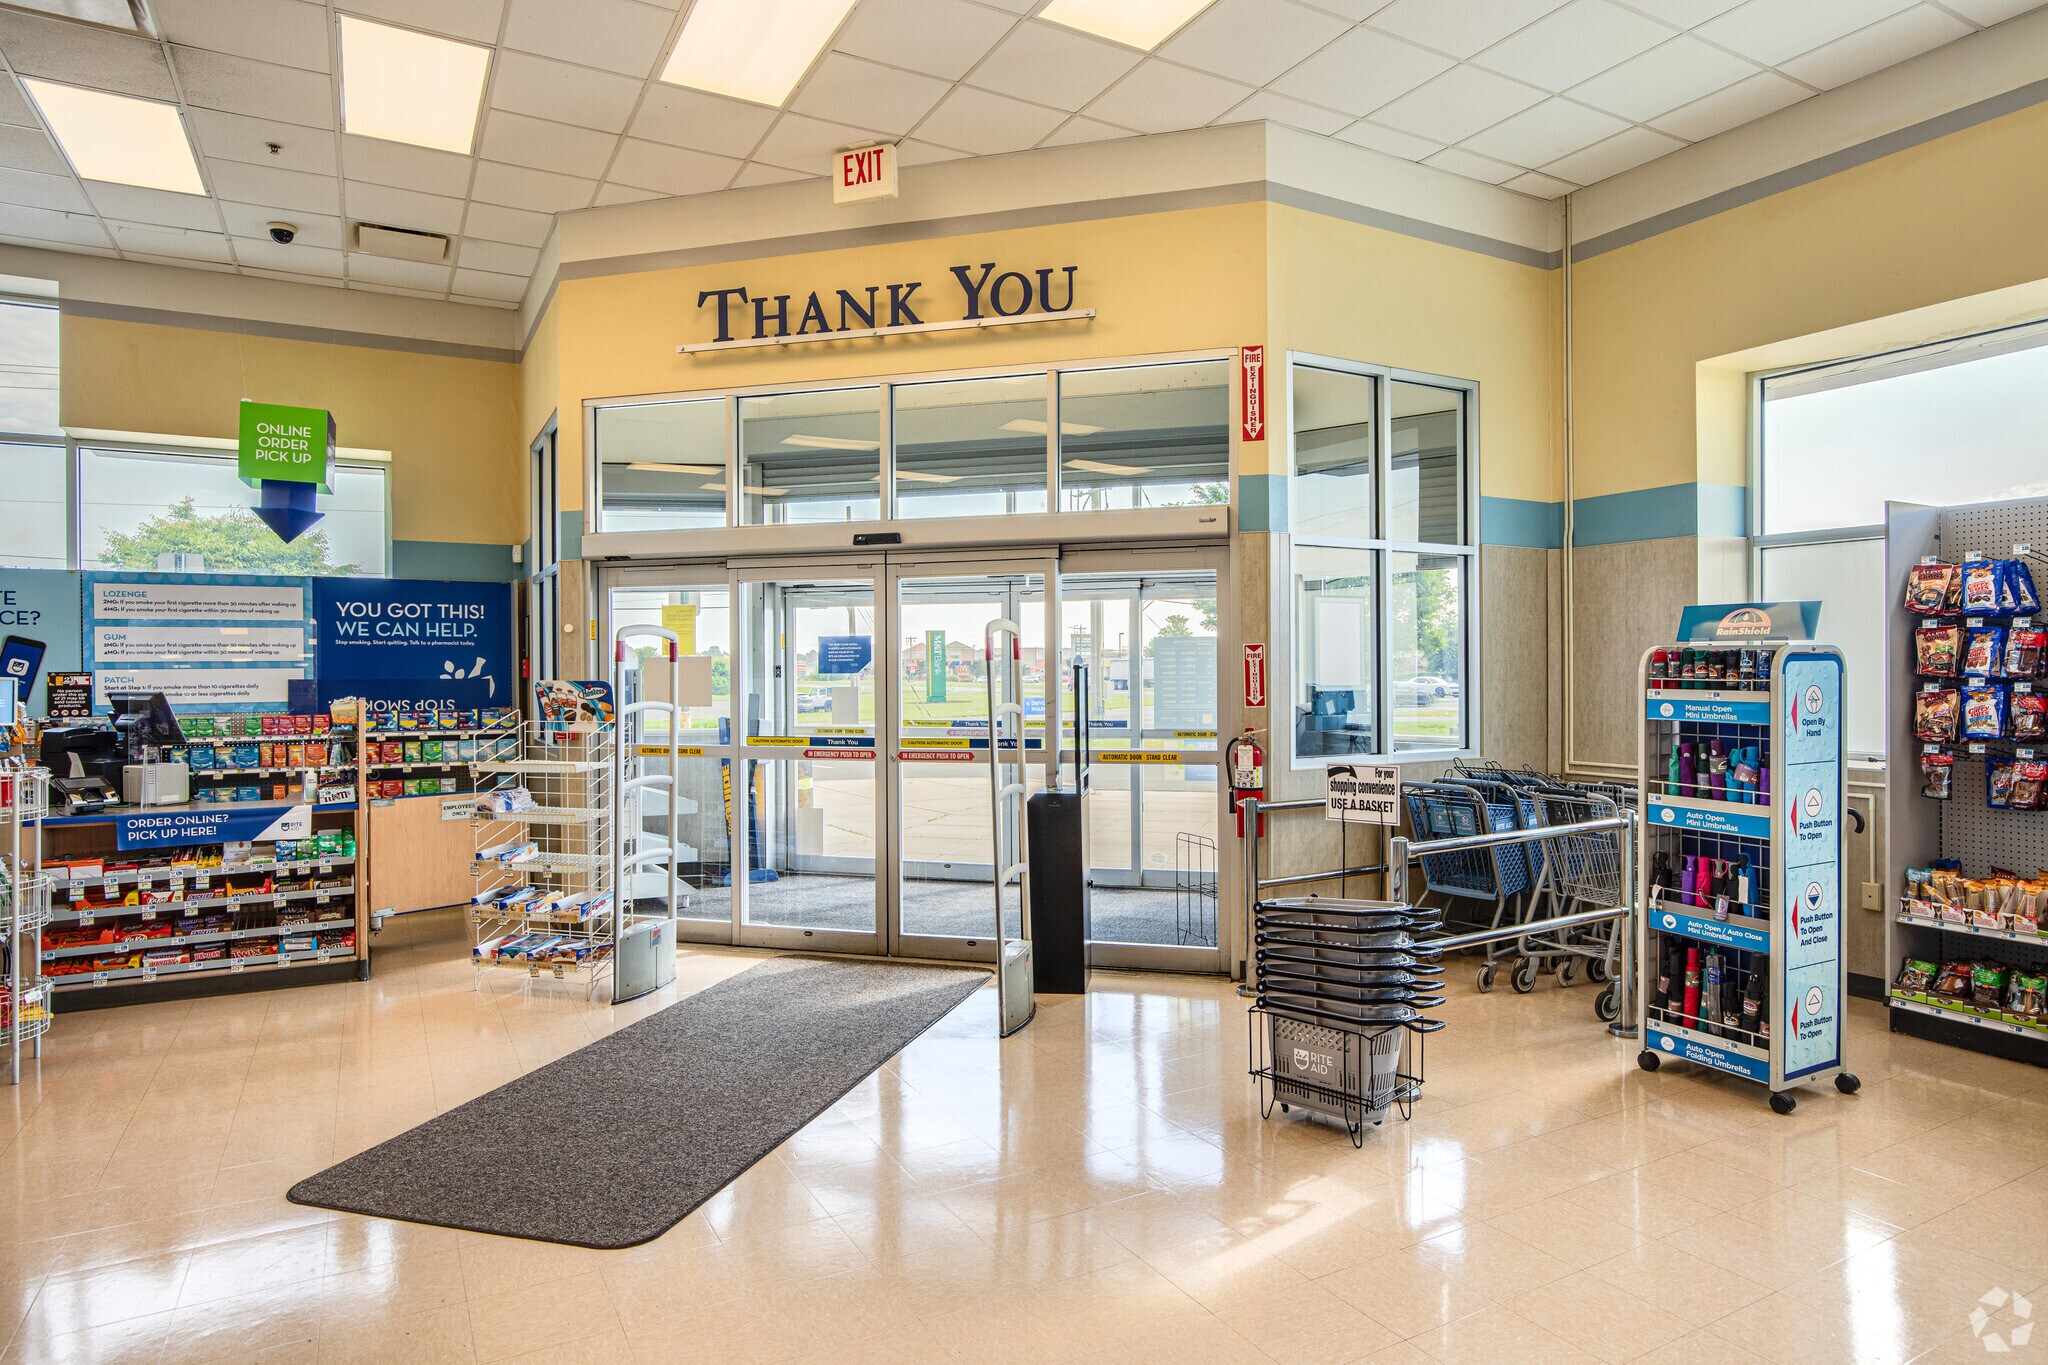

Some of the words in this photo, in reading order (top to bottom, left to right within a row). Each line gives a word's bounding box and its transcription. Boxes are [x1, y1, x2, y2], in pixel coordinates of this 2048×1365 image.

[843, 148, 884, 187] EXIT
[697, 282, 924, 343] THANK
[949, 262, 1078, 320] YOU
[1245, 354, 1260, 363] FIRE
[1249, 365, 1257, 433] EXTINGUISHER
[256, 422, 311, 438] ONLINE
[258, 436, 308, 451] ORDER
[255, 449, 289, 463] PICK
[292, 453, 311, 464] UP
[0, 591, 16, 605] E
[103, 590, 147, 598] LOZENGE
[336, 602, 381, 618] YOU
[387, 603, 432, 619] GOT
[437, 604, 485, 619] THIS!
[335, 621, 369, 637] WE
[375, 621, 419, 637] CAN
[426, 622, 478, 638] HELP.
[1716, 626, 1771, 636] RainShield
[933, 634, 942, 656] M&T
[933, 656, 942, 676] Bank
[582, 689, 605, 698] Hostess
[415, 699, 455, 711] STOP
[1685, 704, 1711, 712] Manual
[1711, 705, 1732, 713] Open
[1685, 711, 1700, 719] Mini
[1701, 713, 1738, 721] Umbrellas
[1801, 718, 1817, 727] Open
[1818, 717, 1826, 726] By
[1806, 728, 1822, 737] Hand
[1375, 768, 1383, 778] For
[1383, 770, 1395, 781] your
[1330, 778, 1357, 796] shopping
[1357, 780, 1396, 796] convenience
[443, 803, 476, 811] EMPLOYEES
[1331, 797, 1348, 810] USE
[1350, 799, 1357, 810] A
[1359, 799, 1394, 813] BASKET
[127, 817, 172, 829] ORDER
[175, 814, 229, 826] ONLINE?
[1686, 811, 1704, 820] Auto
[1705, 813, 1725, 823] Open
[1496, 822, 1506, 831] RITE
[1506, 821, 1514, 829] AID
[1686, 819, 1701, 827] Mini
[1702, 821, 1738, 832] Umbrellas
[1799, 822, 1813, 830] Push
[1813, 819, 1833, 828] Button
[128, 830, 157, 841] PICK
[161, 829, 178, 839] UP
[181, 826, 217, 837] HERE!
[1799, 833, 1806, 841] To
[1807, 831, 1822, 841] Open
[1800, 916, 1813, 924] Push
[1814, 913, 1833, 922] Button
[1687, 920, 1703, 929] Auto
[1703, 923, 1721, 933] Open
[1727, 928, 1744, 937] Auto
[1744, 932, 1763, 942] Close
[1687, 927, 1701, 936] Mini
[1701, 929, 1733, 942] Umbrellas
[1808, 925, 1823, 934] Open
[1800, 938, 1812, 947] And
[1813, 935, 1828, 944] Close
[194, 951, 221, 960] PAYDAY
[231, 948, 261, 959] TWIX
[1799, 1021, 1813, 1030] Push
[1814, 1016, 1833, 1026] Button
[1808, 1029, 1822, 1039] Open
[1686, 1043, 1704, 1053] Auto
[1704, 1048, 1725, 1060] Open
[1310, 1052, 1333, 1067] RITE
[1686, 1051, 1713, 1065] Folding
[1714, 1060, 1751, 1075] Umbrellas
[1310, 1065, 1328, 1075] AID
